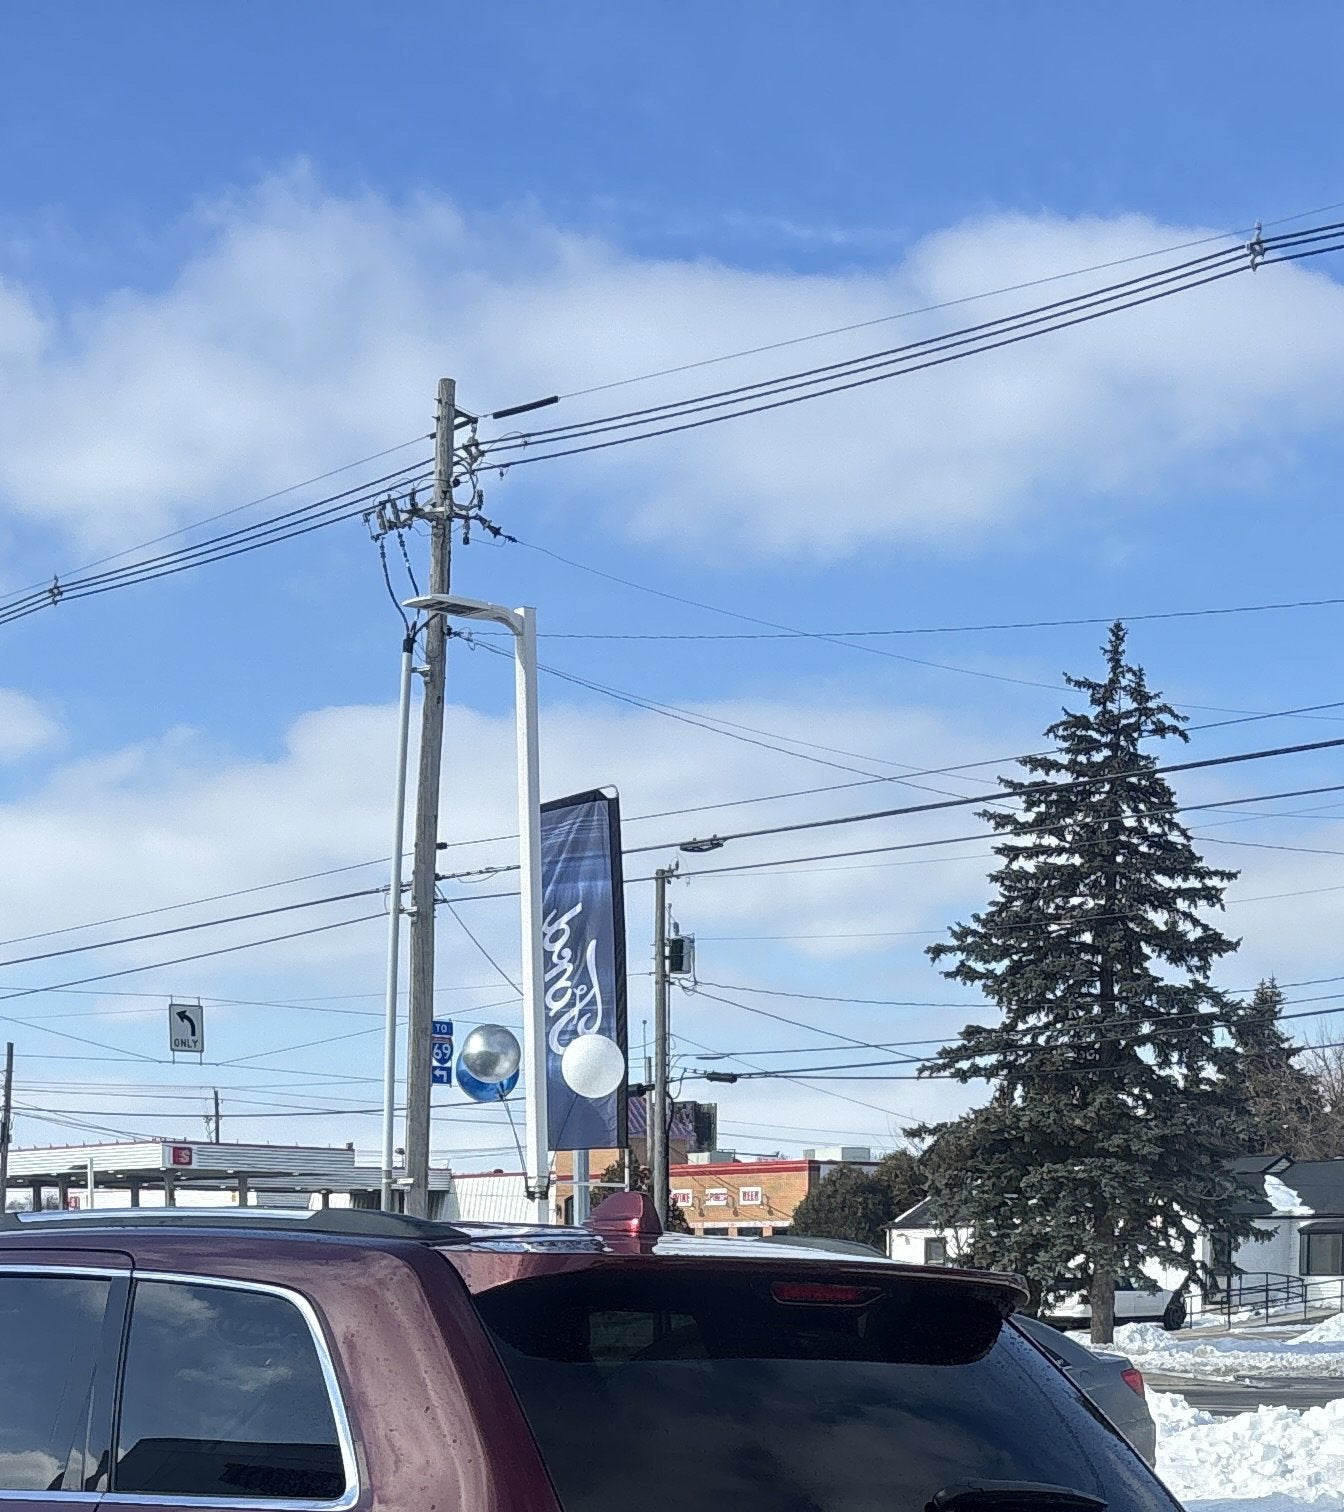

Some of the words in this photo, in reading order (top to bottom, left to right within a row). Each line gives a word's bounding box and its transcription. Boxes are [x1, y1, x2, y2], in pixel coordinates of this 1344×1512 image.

[435, 1023, 448, 1034] TO
[173, 1038, 199, 1049] ONLY
[432, 1043, 451, 1060] 69
